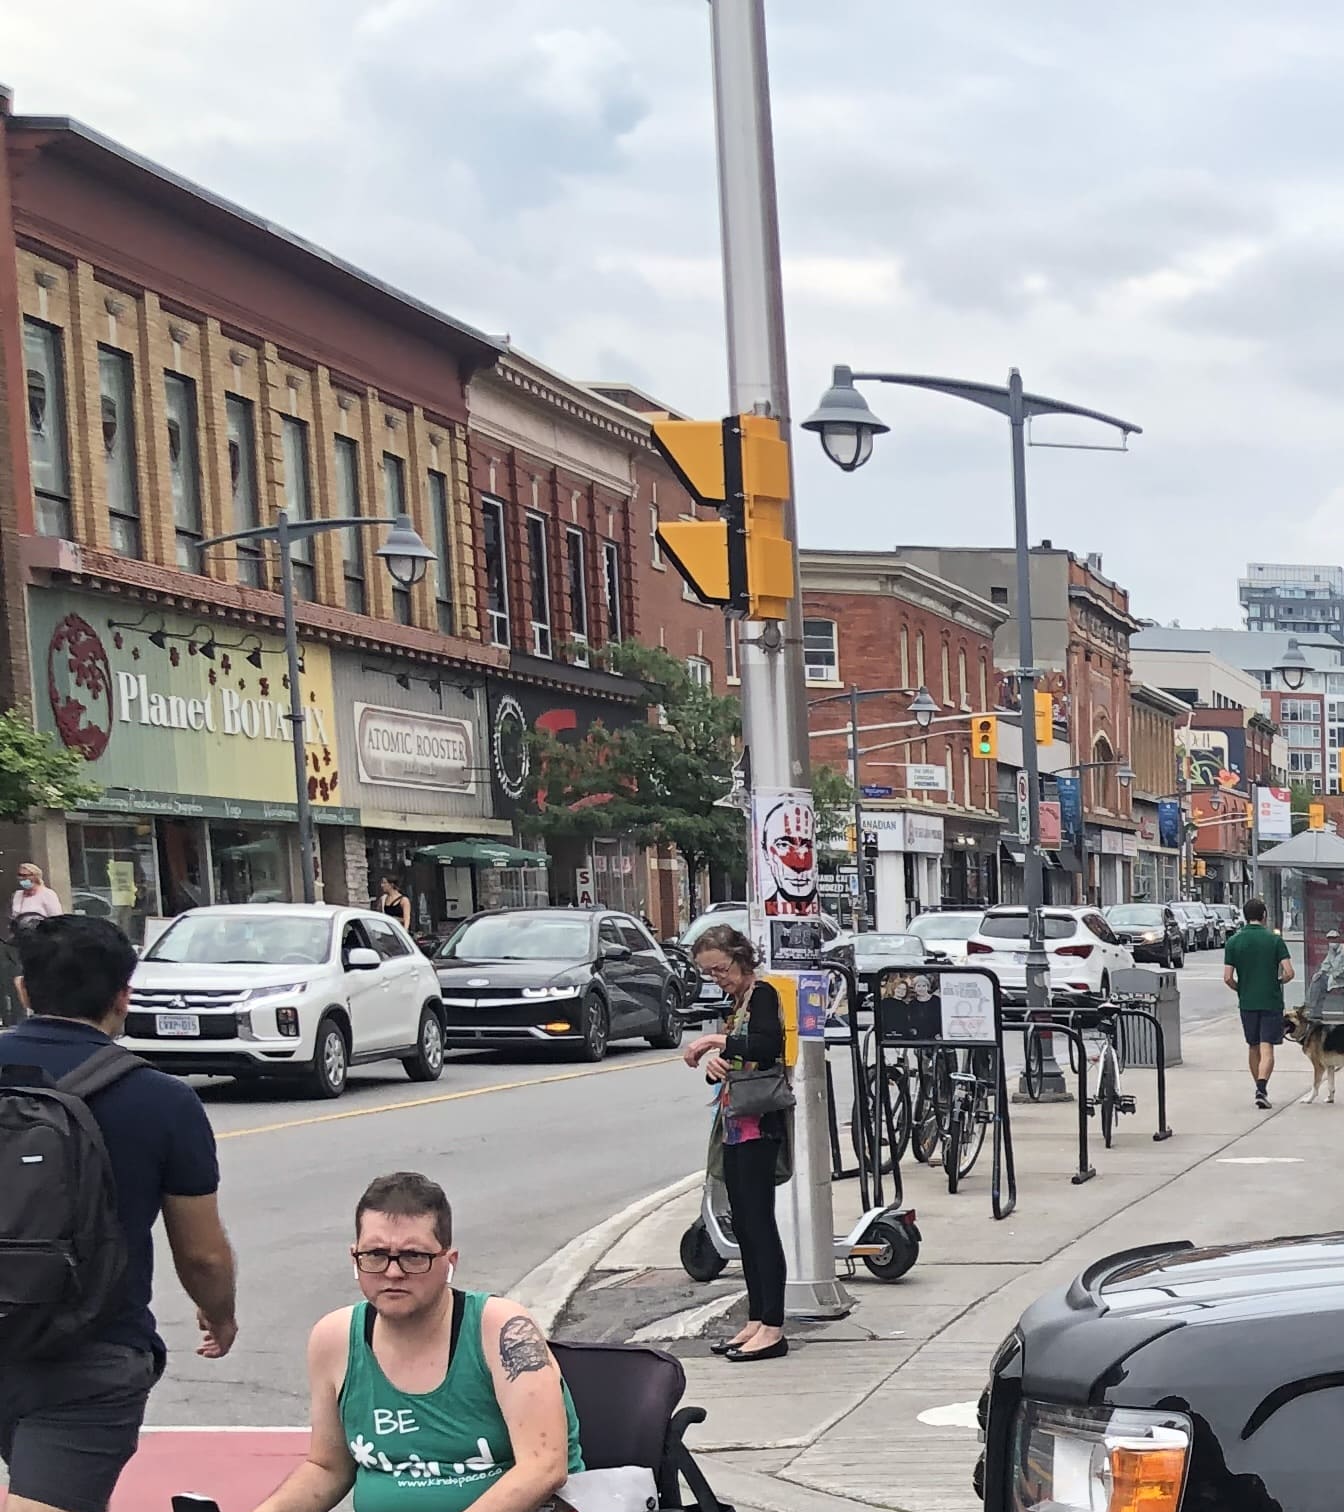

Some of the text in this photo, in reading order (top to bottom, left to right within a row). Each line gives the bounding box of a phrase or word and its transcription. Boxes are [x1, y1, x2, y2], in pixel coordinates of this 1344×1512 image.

[116, 671, 329, 747] Planet BOTAIX
[368, 728, 465, 760] ATOMIC ROOSTER
[862, 819, 896, 830] ANADIAN
[373, 1409, 420, 1435] BE
